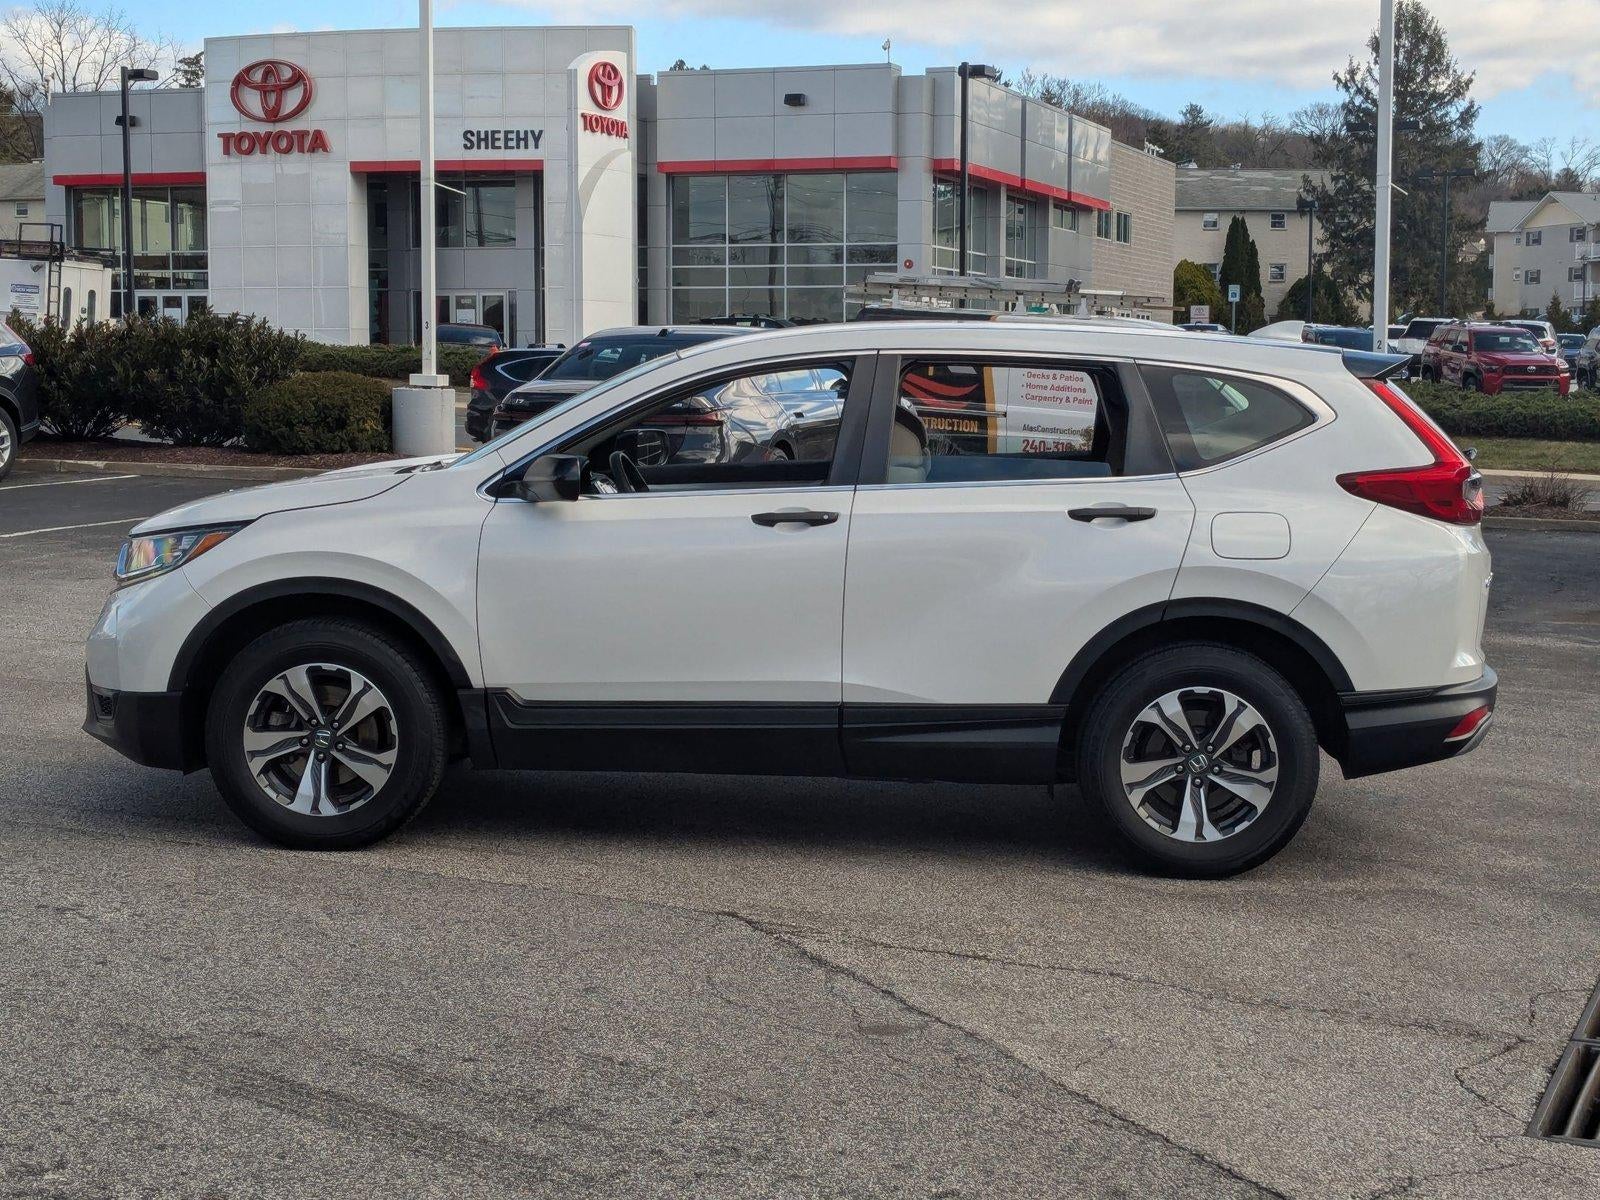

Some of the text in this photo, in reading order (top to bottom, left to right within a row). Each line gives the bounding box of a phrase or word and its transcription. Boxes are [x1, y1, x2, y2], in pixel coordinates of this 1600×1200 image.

[581, 112, 629, 139] TOYOTA
[217, 129, 331, 156] TOYOTA
[462, 129, 544, 150] SHEEHY
[424, 320, 430, 330] 3
[1376, 340, 1382, 349] 2
[1026, 371, 1084, 383] Decks & Patios
[1025, 382, 1087, 394] Home Additions
[1025, 393, 1063, 405] Carpentry
[1072, 398, 1093, 406] Paint
[922, 416, 978, 432] TRUCTION
